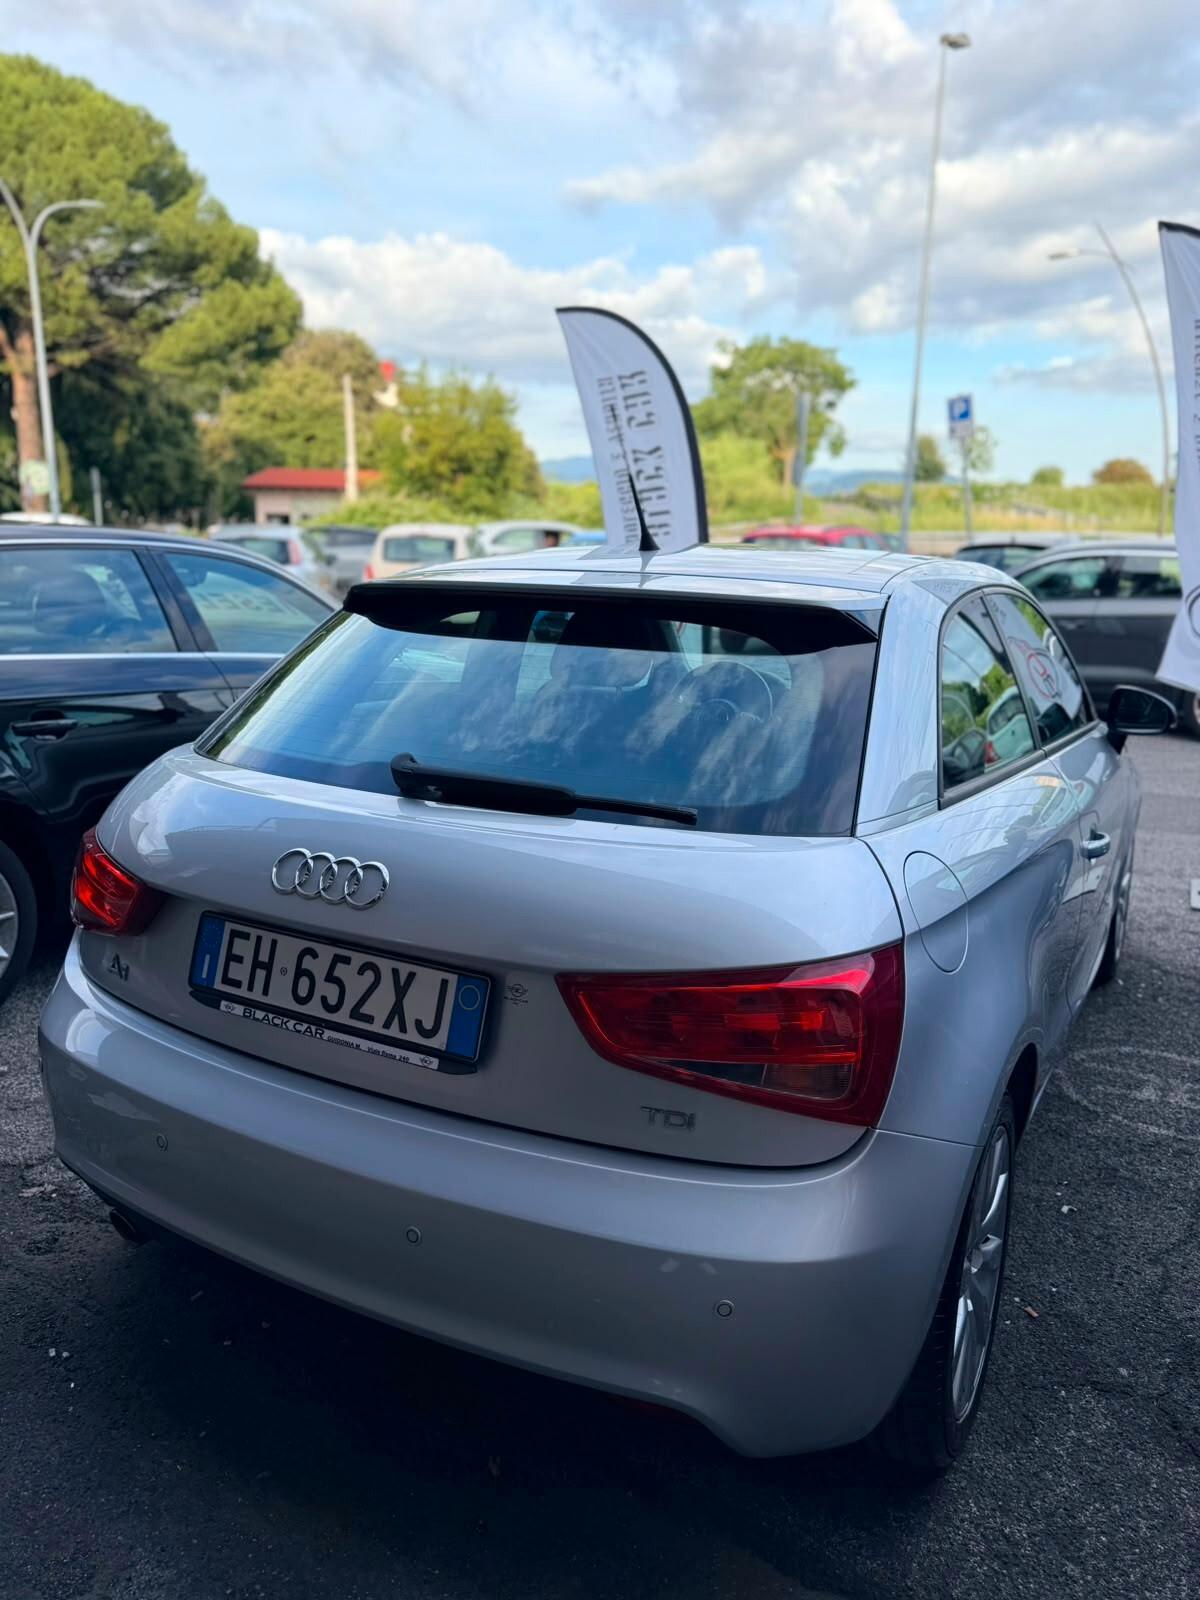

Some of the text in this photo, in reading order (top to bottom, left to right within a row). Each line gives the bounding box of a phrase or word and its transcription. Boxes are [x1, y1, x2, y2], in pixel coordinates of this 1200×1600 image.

[220, 928, 449, 1039] EH 652XJ
[242, 1007, 290, 1031] BLACK
[293, 1022, 325, 1040] CAR
[640, 1104, 697, 1131] TDI
